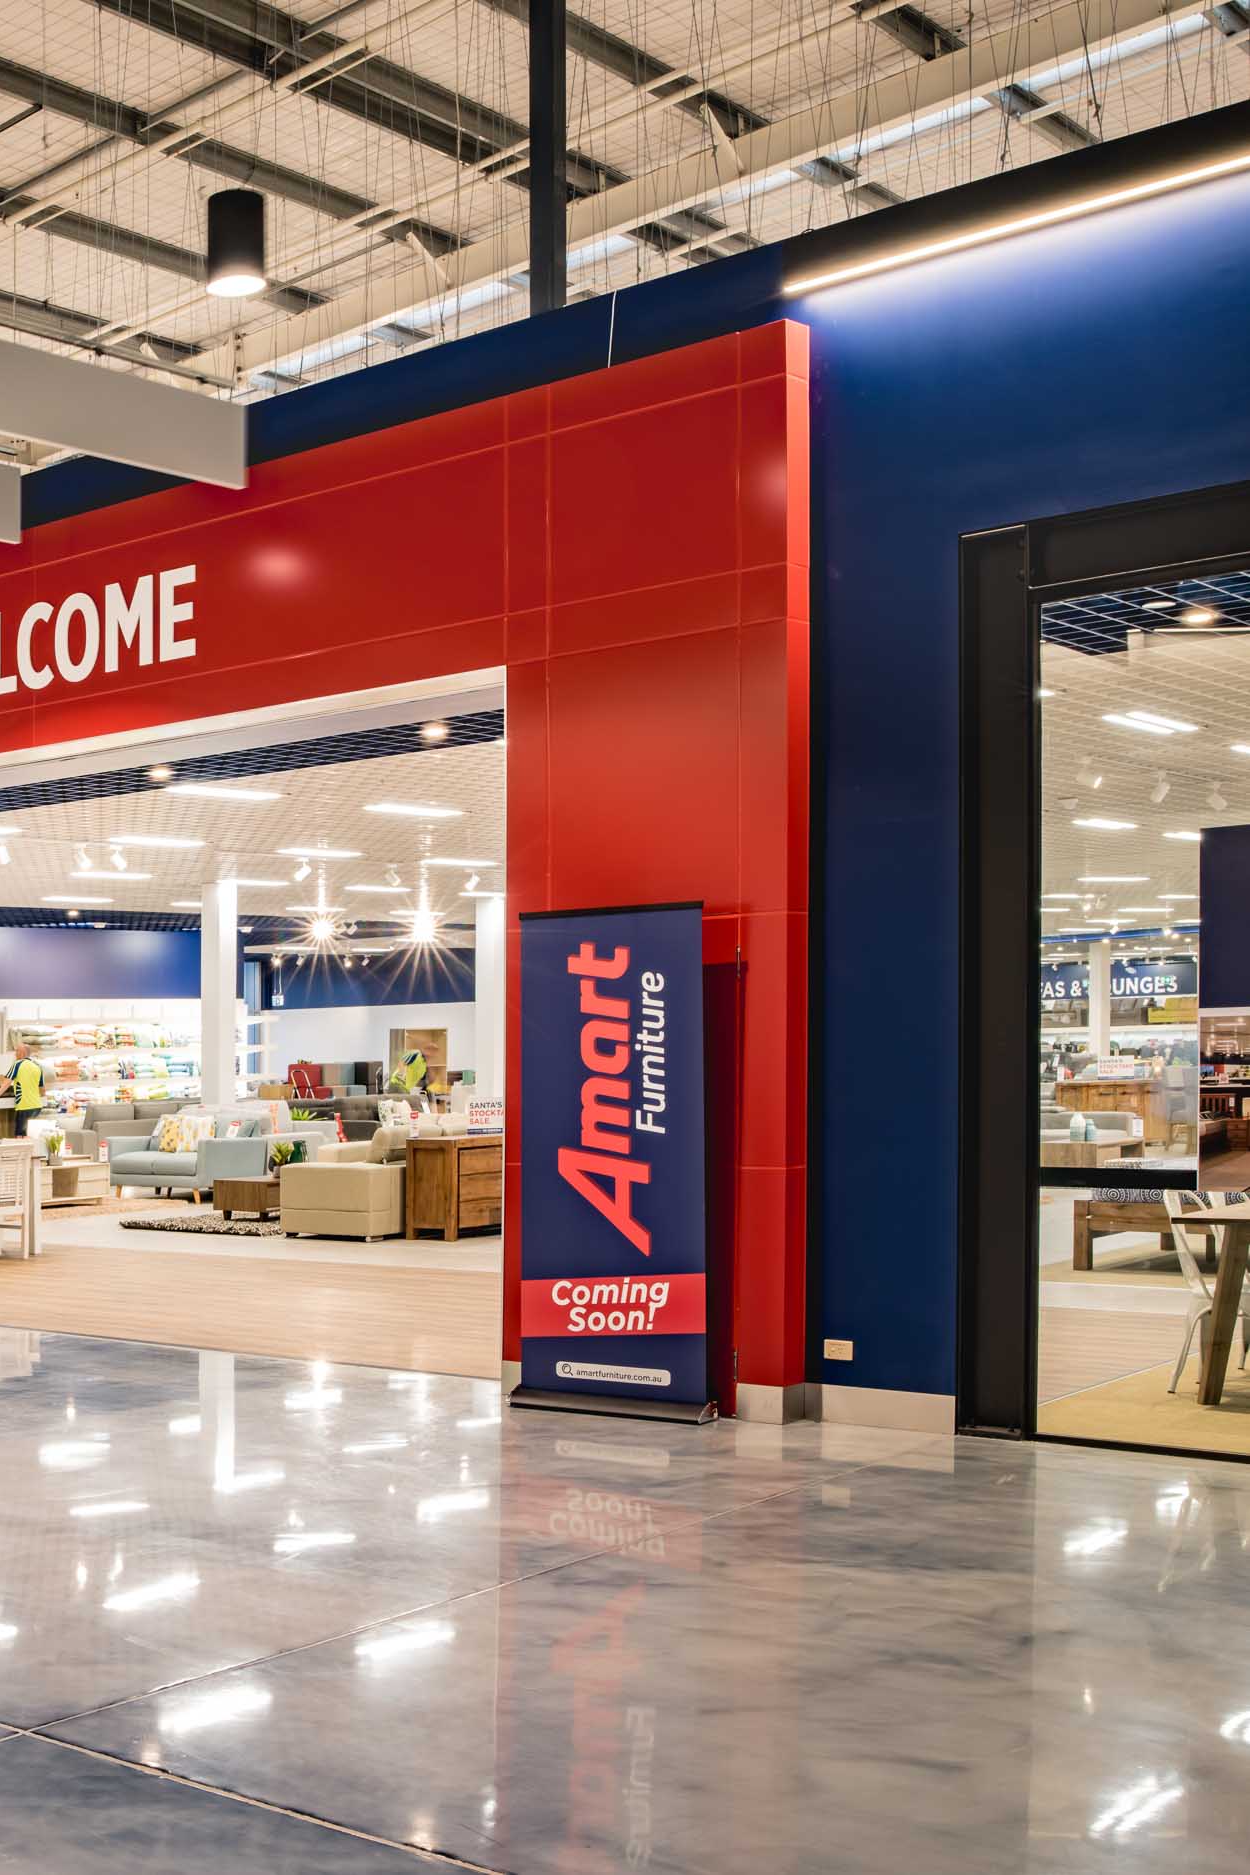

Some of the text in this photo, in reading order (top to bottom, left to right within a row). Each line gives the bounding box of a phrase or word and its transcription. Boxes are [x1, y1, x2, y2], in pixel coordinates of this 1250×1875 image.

[1070, 980, 1082, 996] &
[1087, 975, 1178, 996] UNGES
[636, 971, 665, 1134] Furniture
[469, 1101, 503, 1109] SANTA'S
[558, 942, 650, 1256] Amart
[552, 1277, 670, 1309] Coming
[567, 1303, 656, 1332] Soon!
[576, 1366, 663, 1384] amartfurniture.com.au
